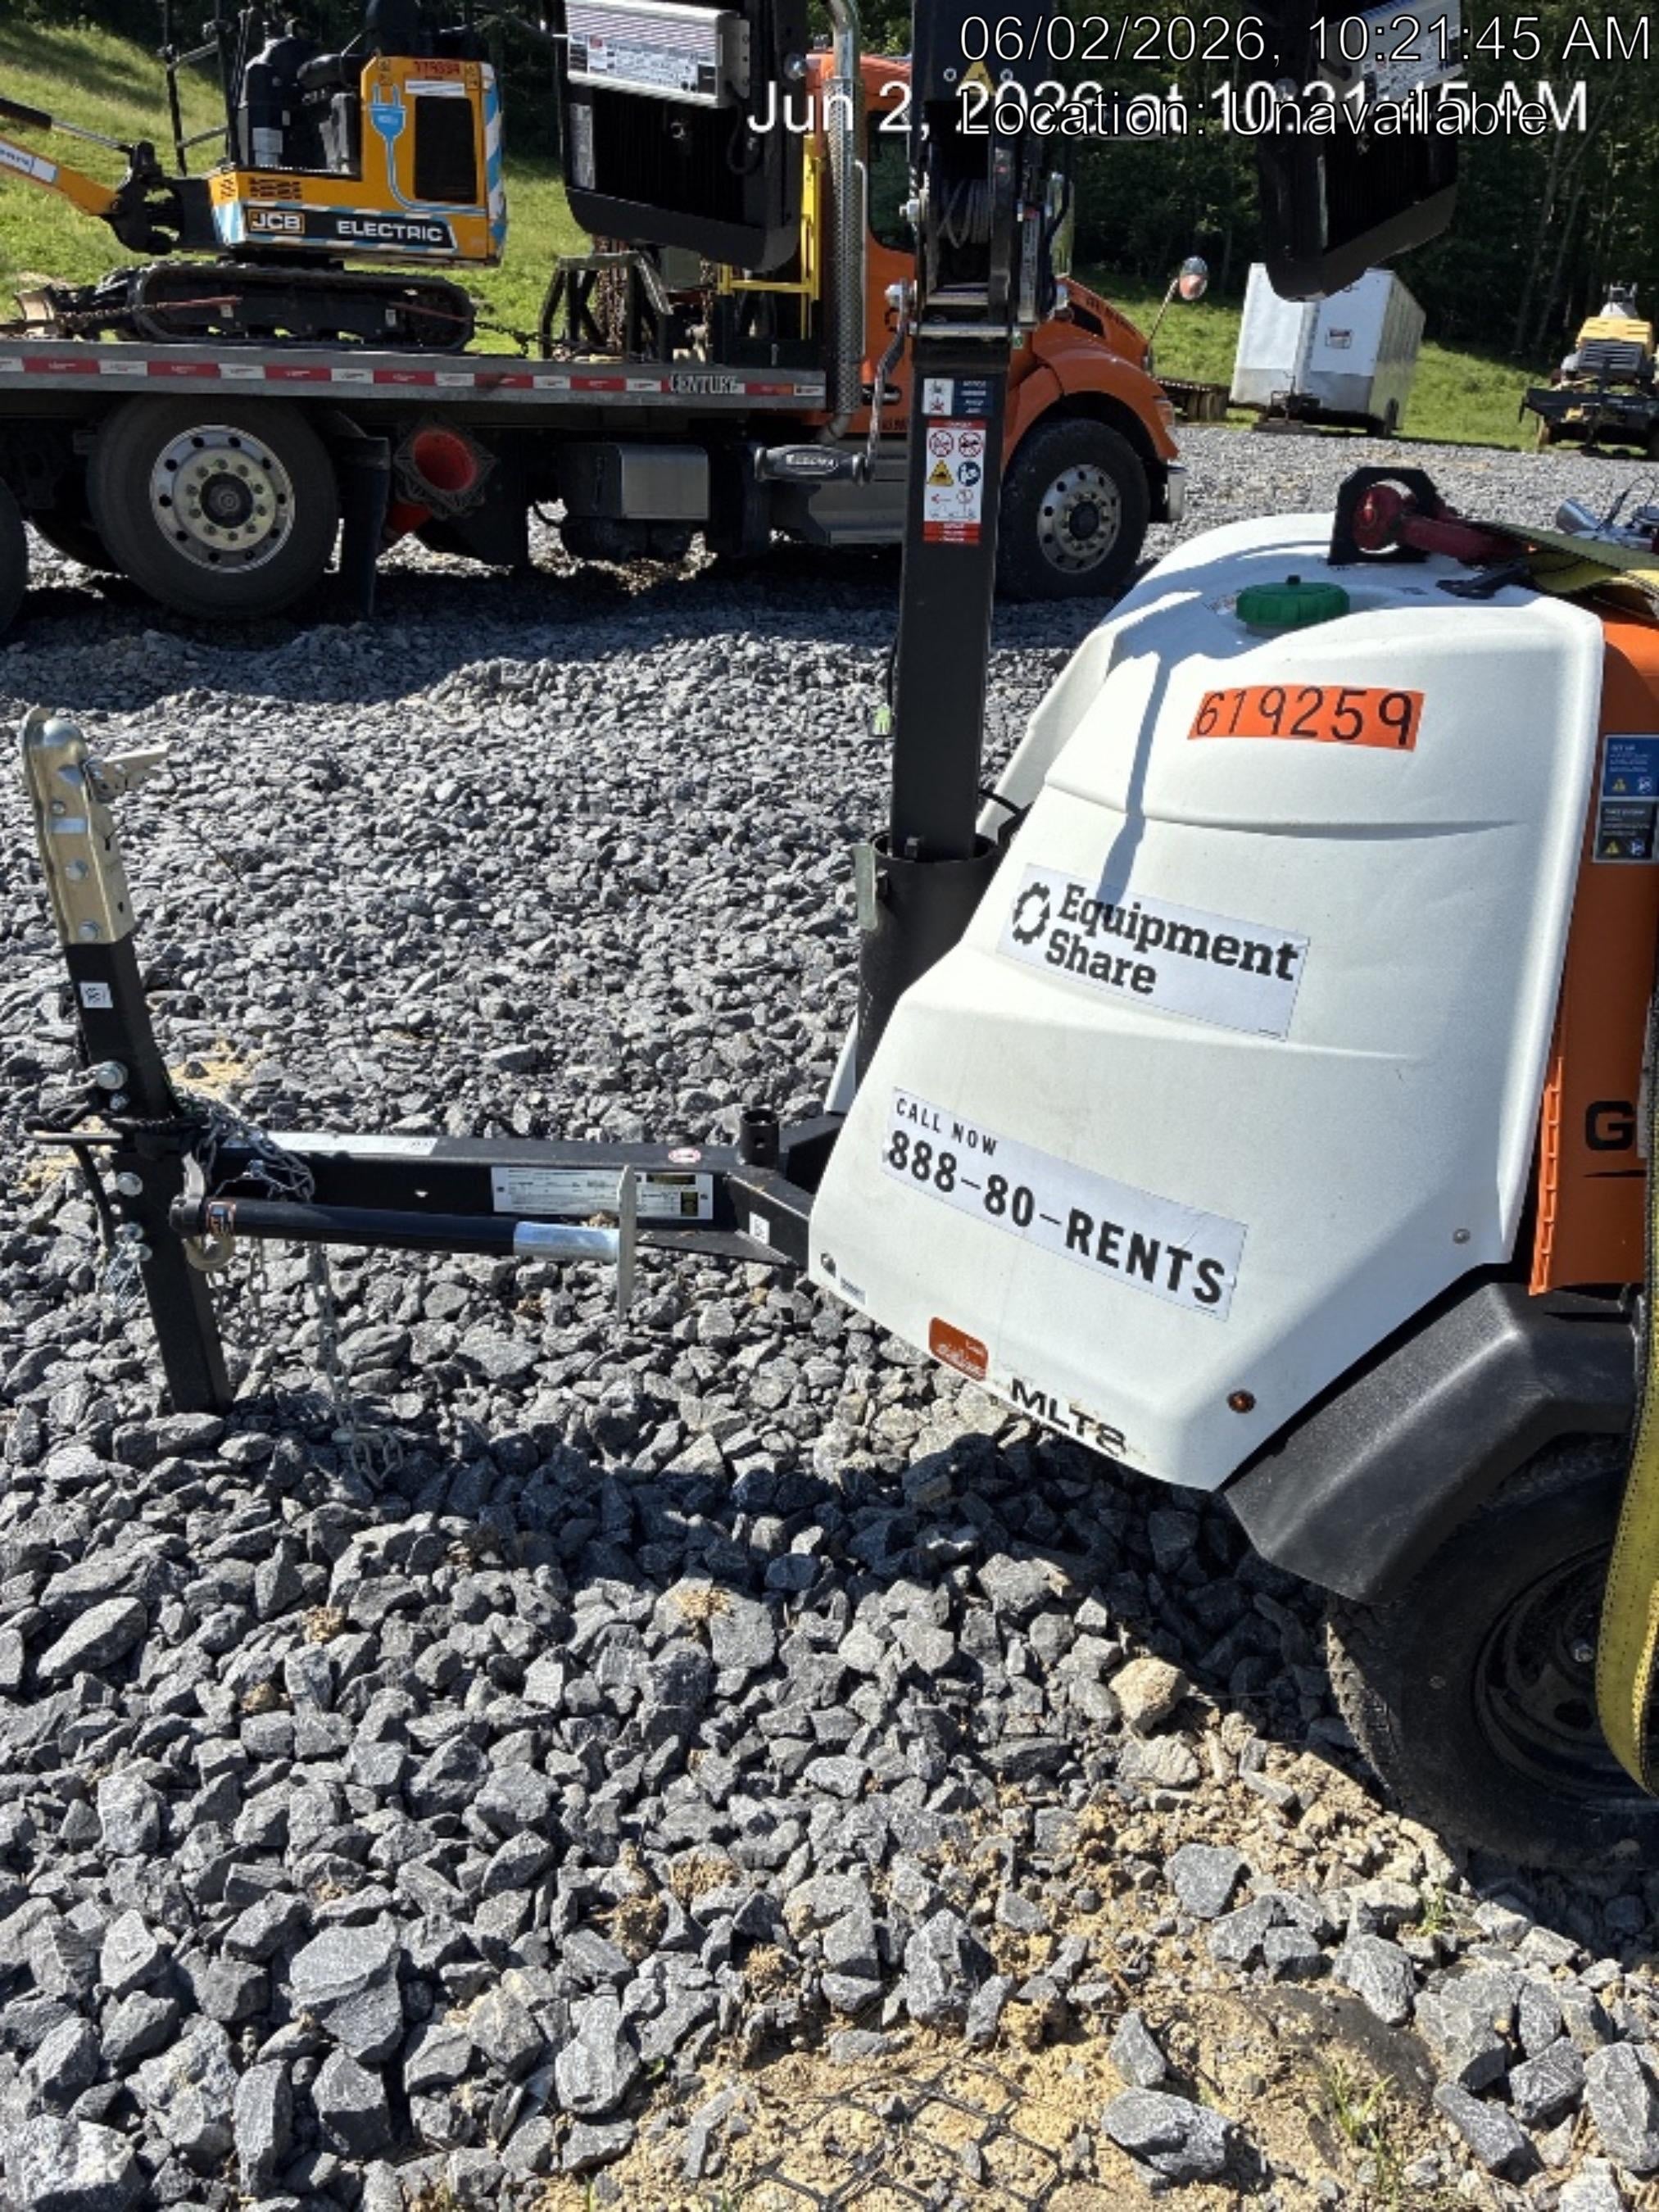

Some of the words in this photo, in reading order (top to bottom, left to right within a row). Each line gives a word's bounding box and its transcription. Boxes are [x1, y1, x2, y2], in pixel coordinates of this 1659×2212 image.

[250, 214, 301, 230] JCB
[337, 220, 443, 242] ELECTRIC
[1197, 686, 1413, 746] 619259
[1045, 927, 1157, 995] Share
[1058, 883, 1299, 981] Equipment
[896, 1098, 941, 1133] CALL
[952, 1122, 999, 1157] NOW
[888, 1130, 1226, 1304] 888-80-RENTS
